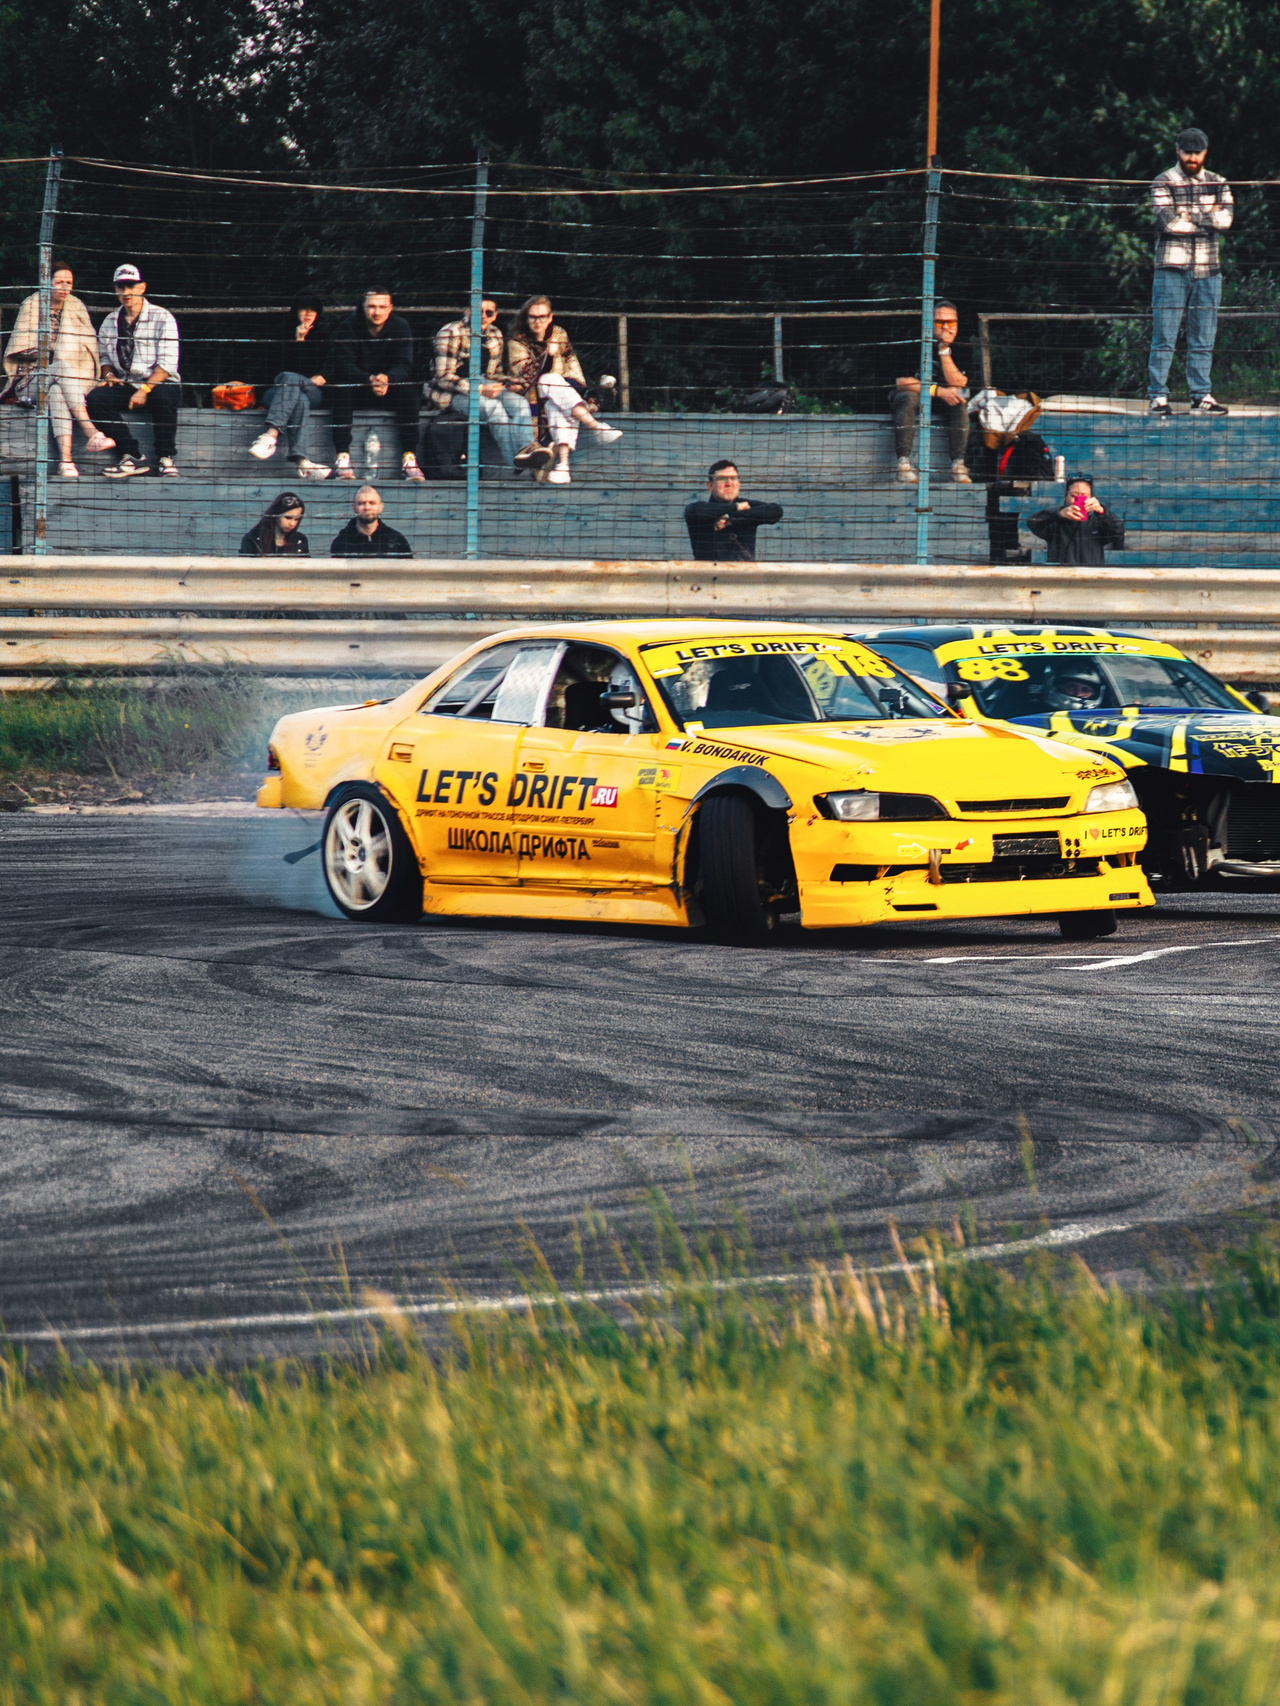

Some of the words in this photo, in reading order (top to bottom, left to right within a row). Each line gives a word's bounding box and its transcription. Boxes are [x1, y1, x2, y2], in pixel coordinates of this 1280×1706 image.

[675, 643, 747, 661] LET'S
[751, 642, 820, 653] DRIFT
[978, 642, 1043, 655] LET'S
[1052, 641, 1121, 653] DRIFT
[815, 654, 896, 679] 118
[957, 657, 1030, 682] 88
[680, 741, 694, 753] V.
[693, 743, 770, 766] BONDARUK
[416, 769, 498, 806] LET'S
[448, 827, 514, 855] ШКОЛА
[518, 833, 591, 861] ДРИФТА
[1102, 827, 1126, 839] LET'S
